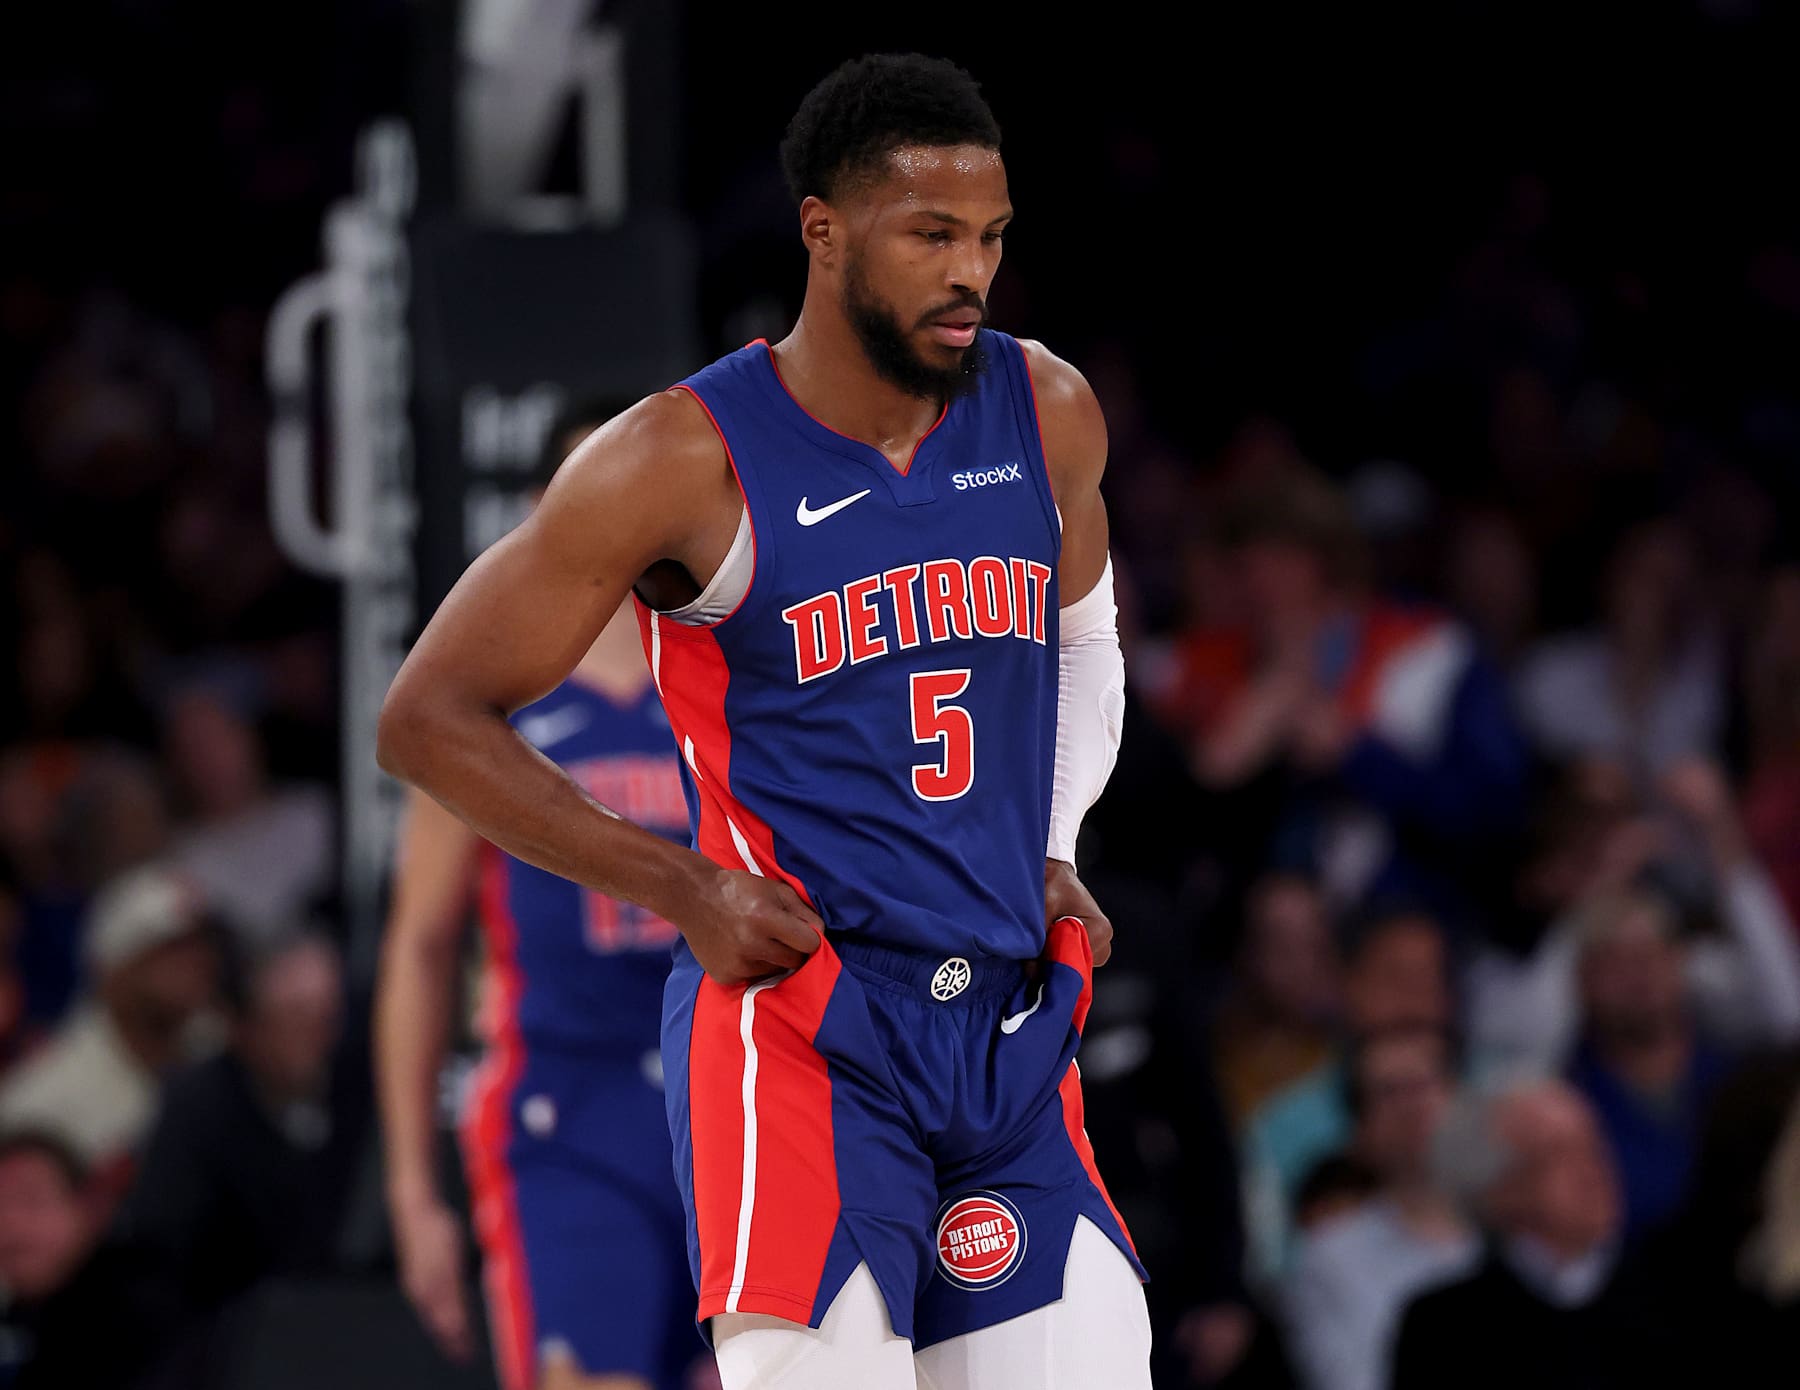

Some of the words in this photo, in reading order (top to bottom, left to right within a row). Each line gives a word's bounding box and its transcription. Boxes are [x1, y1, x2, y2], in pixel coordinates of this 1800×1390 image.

[952, 463, 1022, 490] StockX
[782, 556, 1051, 684] DETROIT
[910, 668, 974, 802] 5
[946, 1218, 1002, 1246] DETROIT
[950, 1233, 1008, 1262] PISTONS
